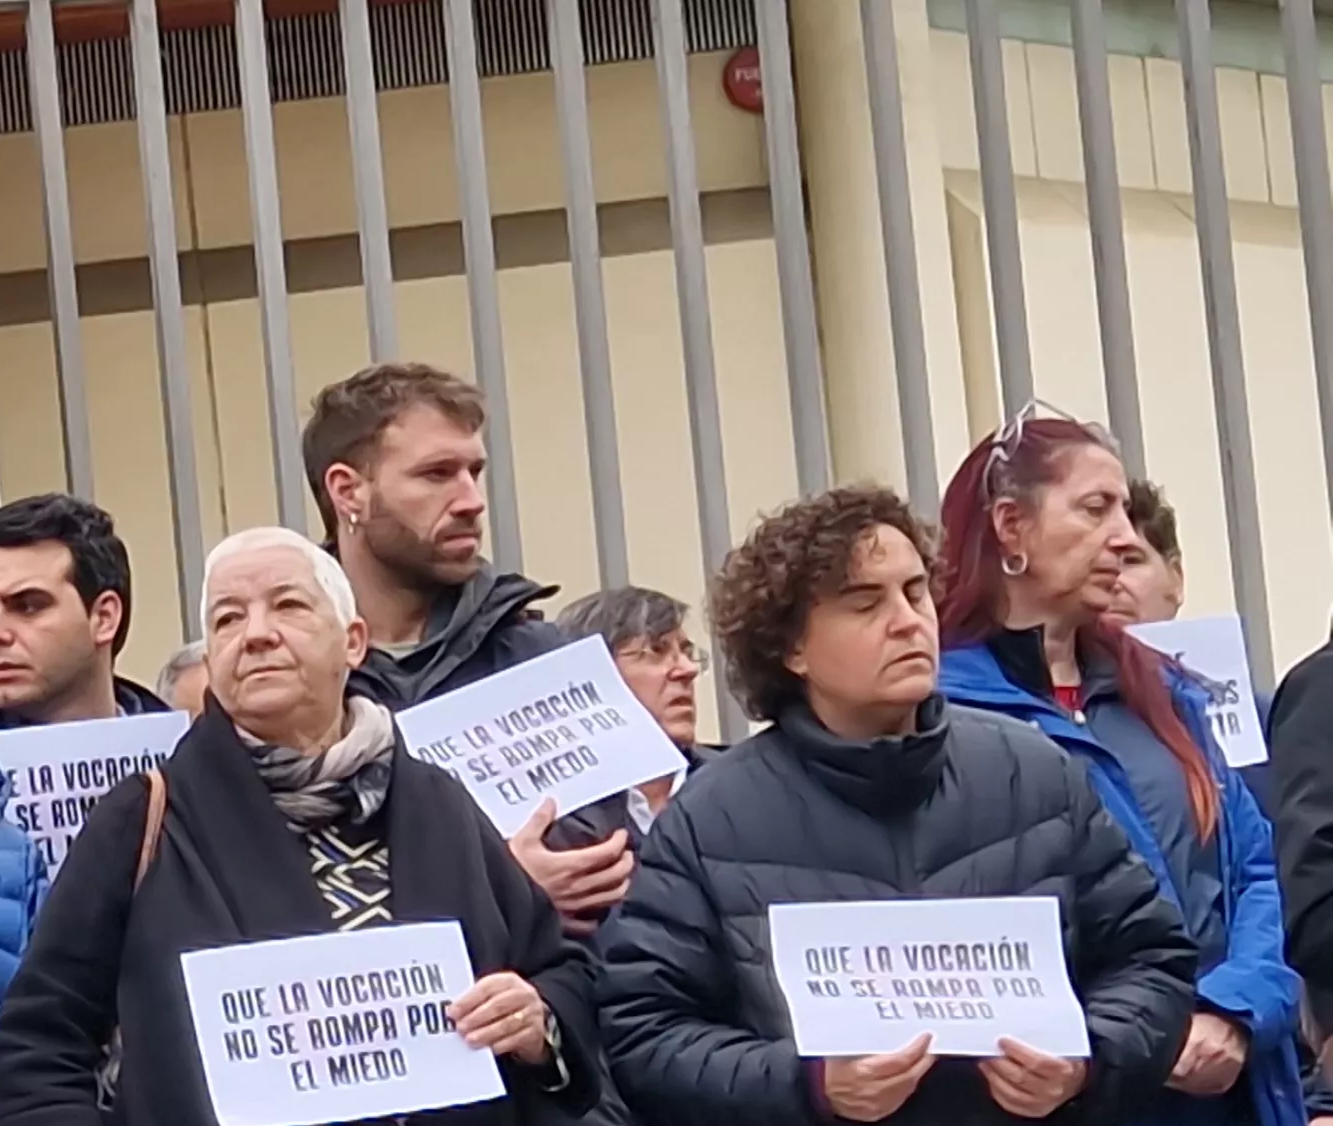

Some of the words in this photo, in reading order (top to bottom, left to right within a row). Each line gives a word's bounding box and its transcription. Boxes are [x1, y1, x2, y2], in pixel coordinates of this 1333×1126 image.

[463, 725, 496, 751] LA
[494, 680, 604, 737] VOCACIÓN
[466, 754, 501, 783] SE
[498, 724, 578, 769] ROMPA
[580, 707, 629, 737] POR
[28, 764, 54, 796] LA
[495, 777, 528, 806] EL
[526, 744, 600, 793] MIEDO
[15, 802, 44, 832] SE
[804, 946, 854, 977] QUE
[864, 946, 893, 974] LA
[902, 937, 1033, 972] VOCACIÓN
[221, 986, 271, 1024] QUE
[278, 981, 310, 1015] LA
[317, 959, 447, 1008] VOCACIÓN
[806, 979, 840, 998] NO
[851, 979, 884, 998] SE
[891, 978, 985, 999] ROMPA
[993, 977, 1047, 998] POR
[877, 1001, 904, 1020] EL
[916, 1000, 996, 1020] MIEDO
[223, 1029, 259, 1063] NO
[267, 1022, 300, 1056] SE
[306, 1007, 399, 1051] ROMPA
[406, 999, 457, 1037] POR
[290, 1059, 320, 1092] EL
[326, 1047, 408, 1087] MIEDO
